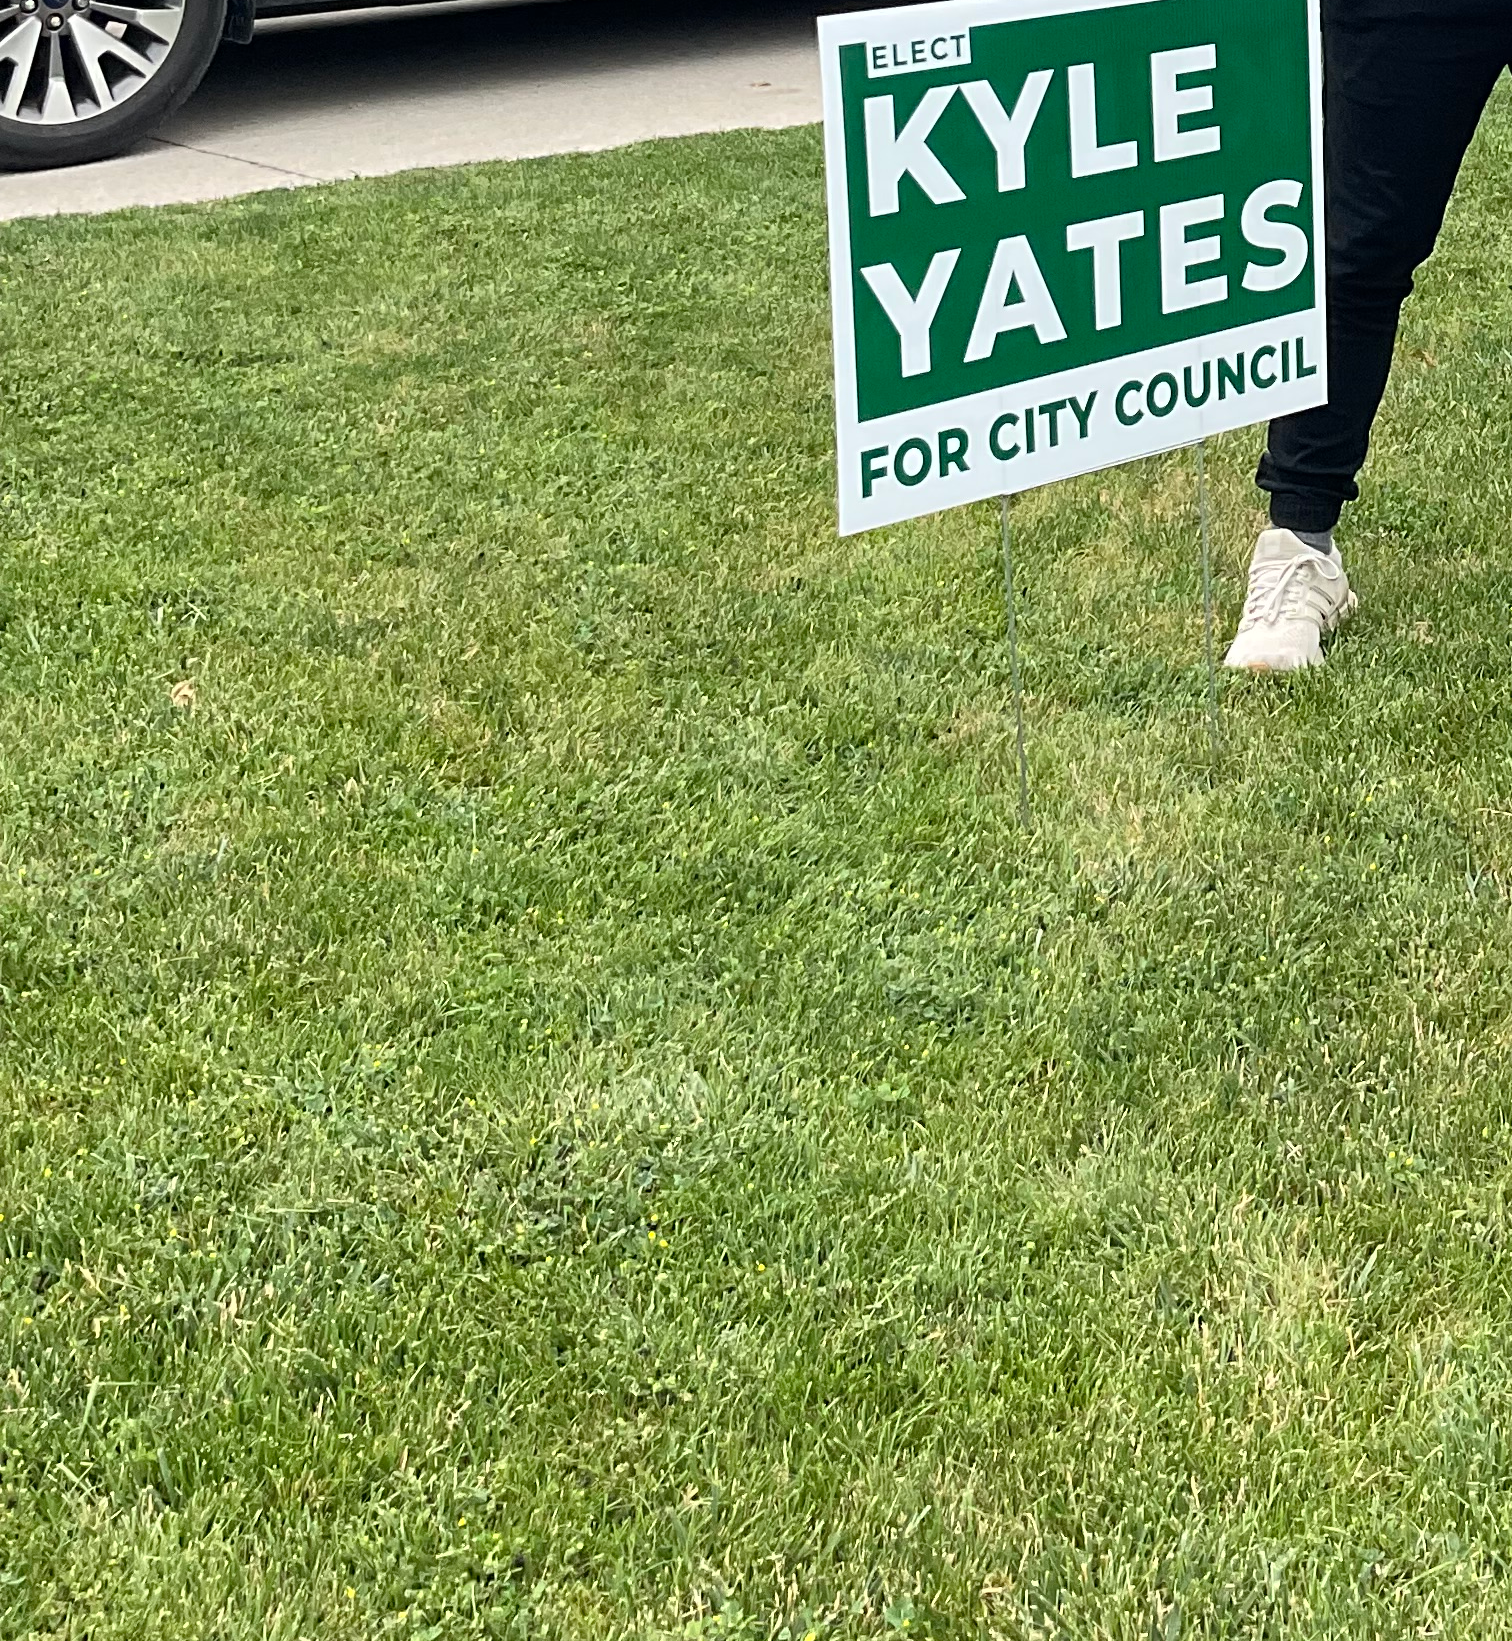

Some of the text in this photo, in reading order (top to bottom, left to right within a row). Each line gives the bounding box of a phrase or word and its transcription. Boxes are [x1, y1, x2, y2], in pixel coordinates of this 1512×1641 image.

[863, 43, 1221, 218] KYLE
[873, 34, 966, 70] ELECT
[860, 179, 1309, 378] YATES
[861, 336, 1318, 499] FOR CITY COUNCIL
